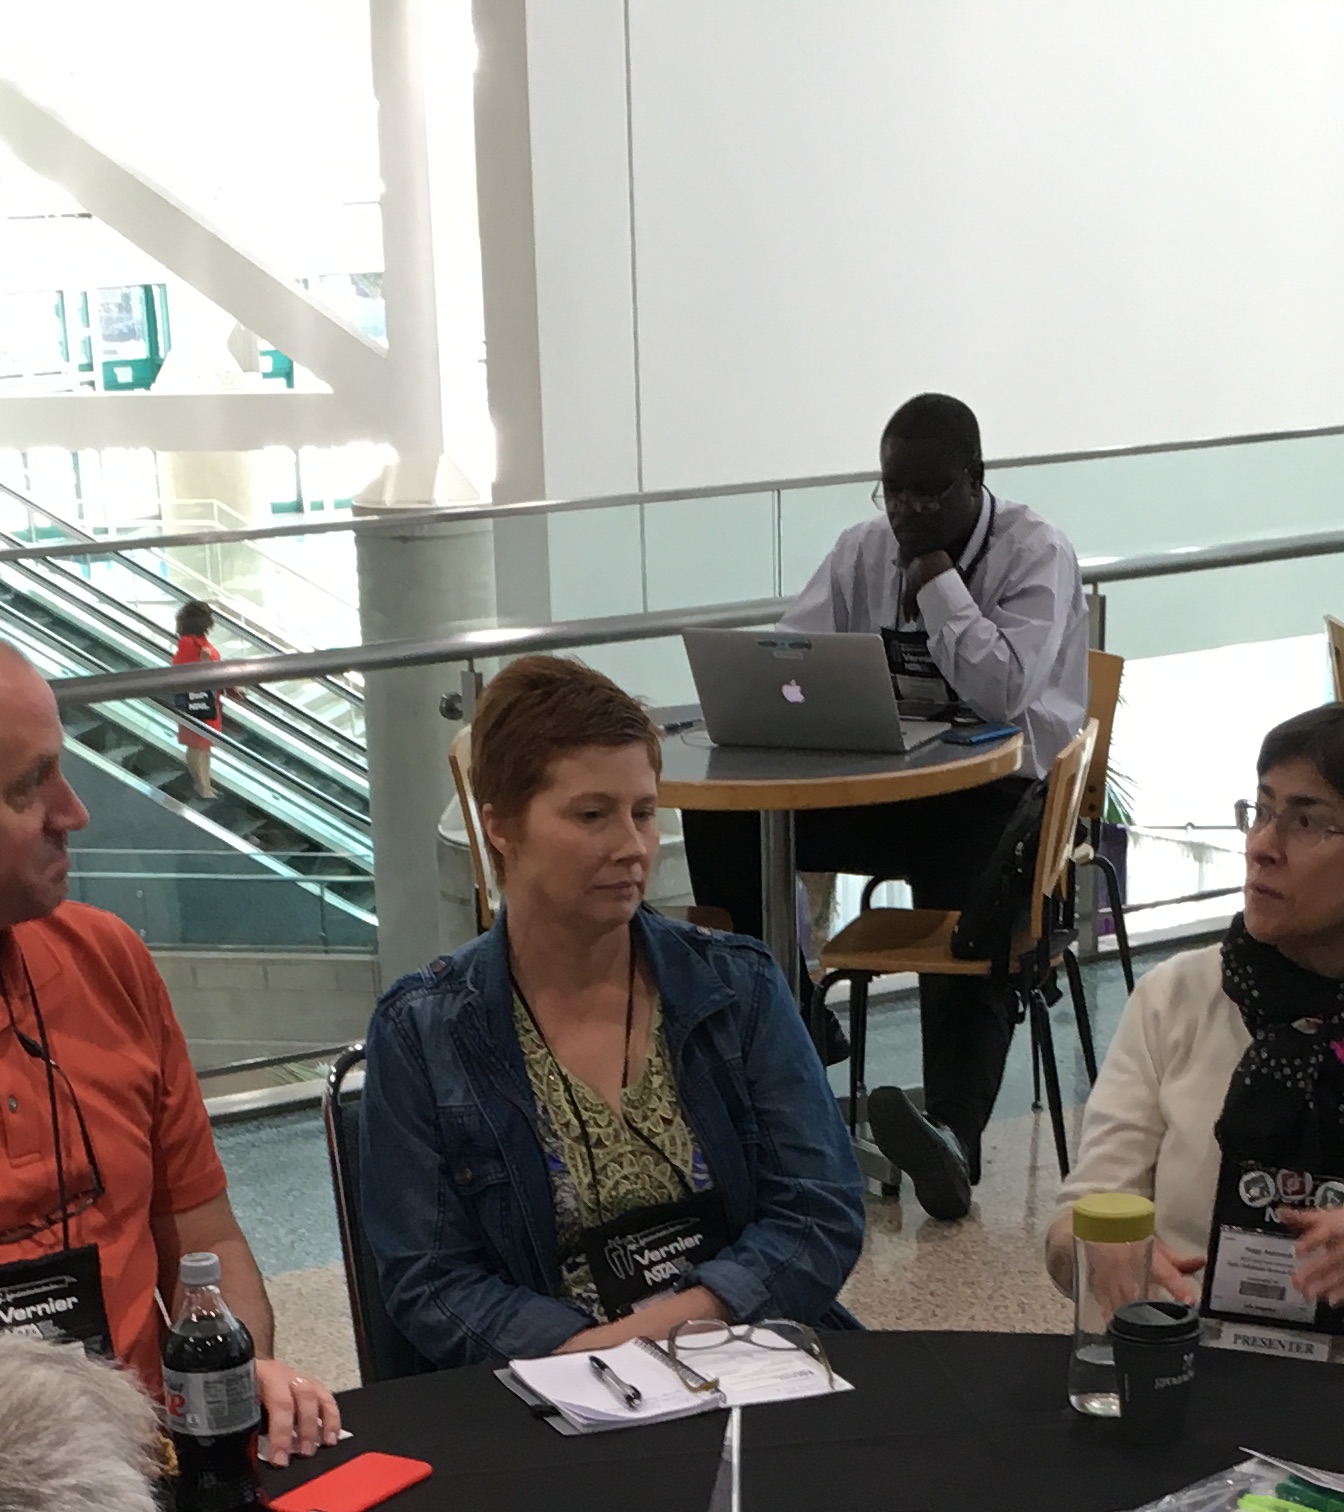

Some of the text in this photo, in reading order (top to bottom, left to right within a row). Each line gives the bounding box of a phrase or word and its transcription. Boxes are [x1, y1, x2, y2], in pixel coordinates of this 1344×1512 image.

[633, 1233, 704, 1266] Vernier
[643, 1261, 681, 1287] NSTA
[1232, 1333, 1315, 1355] PRESENTER
